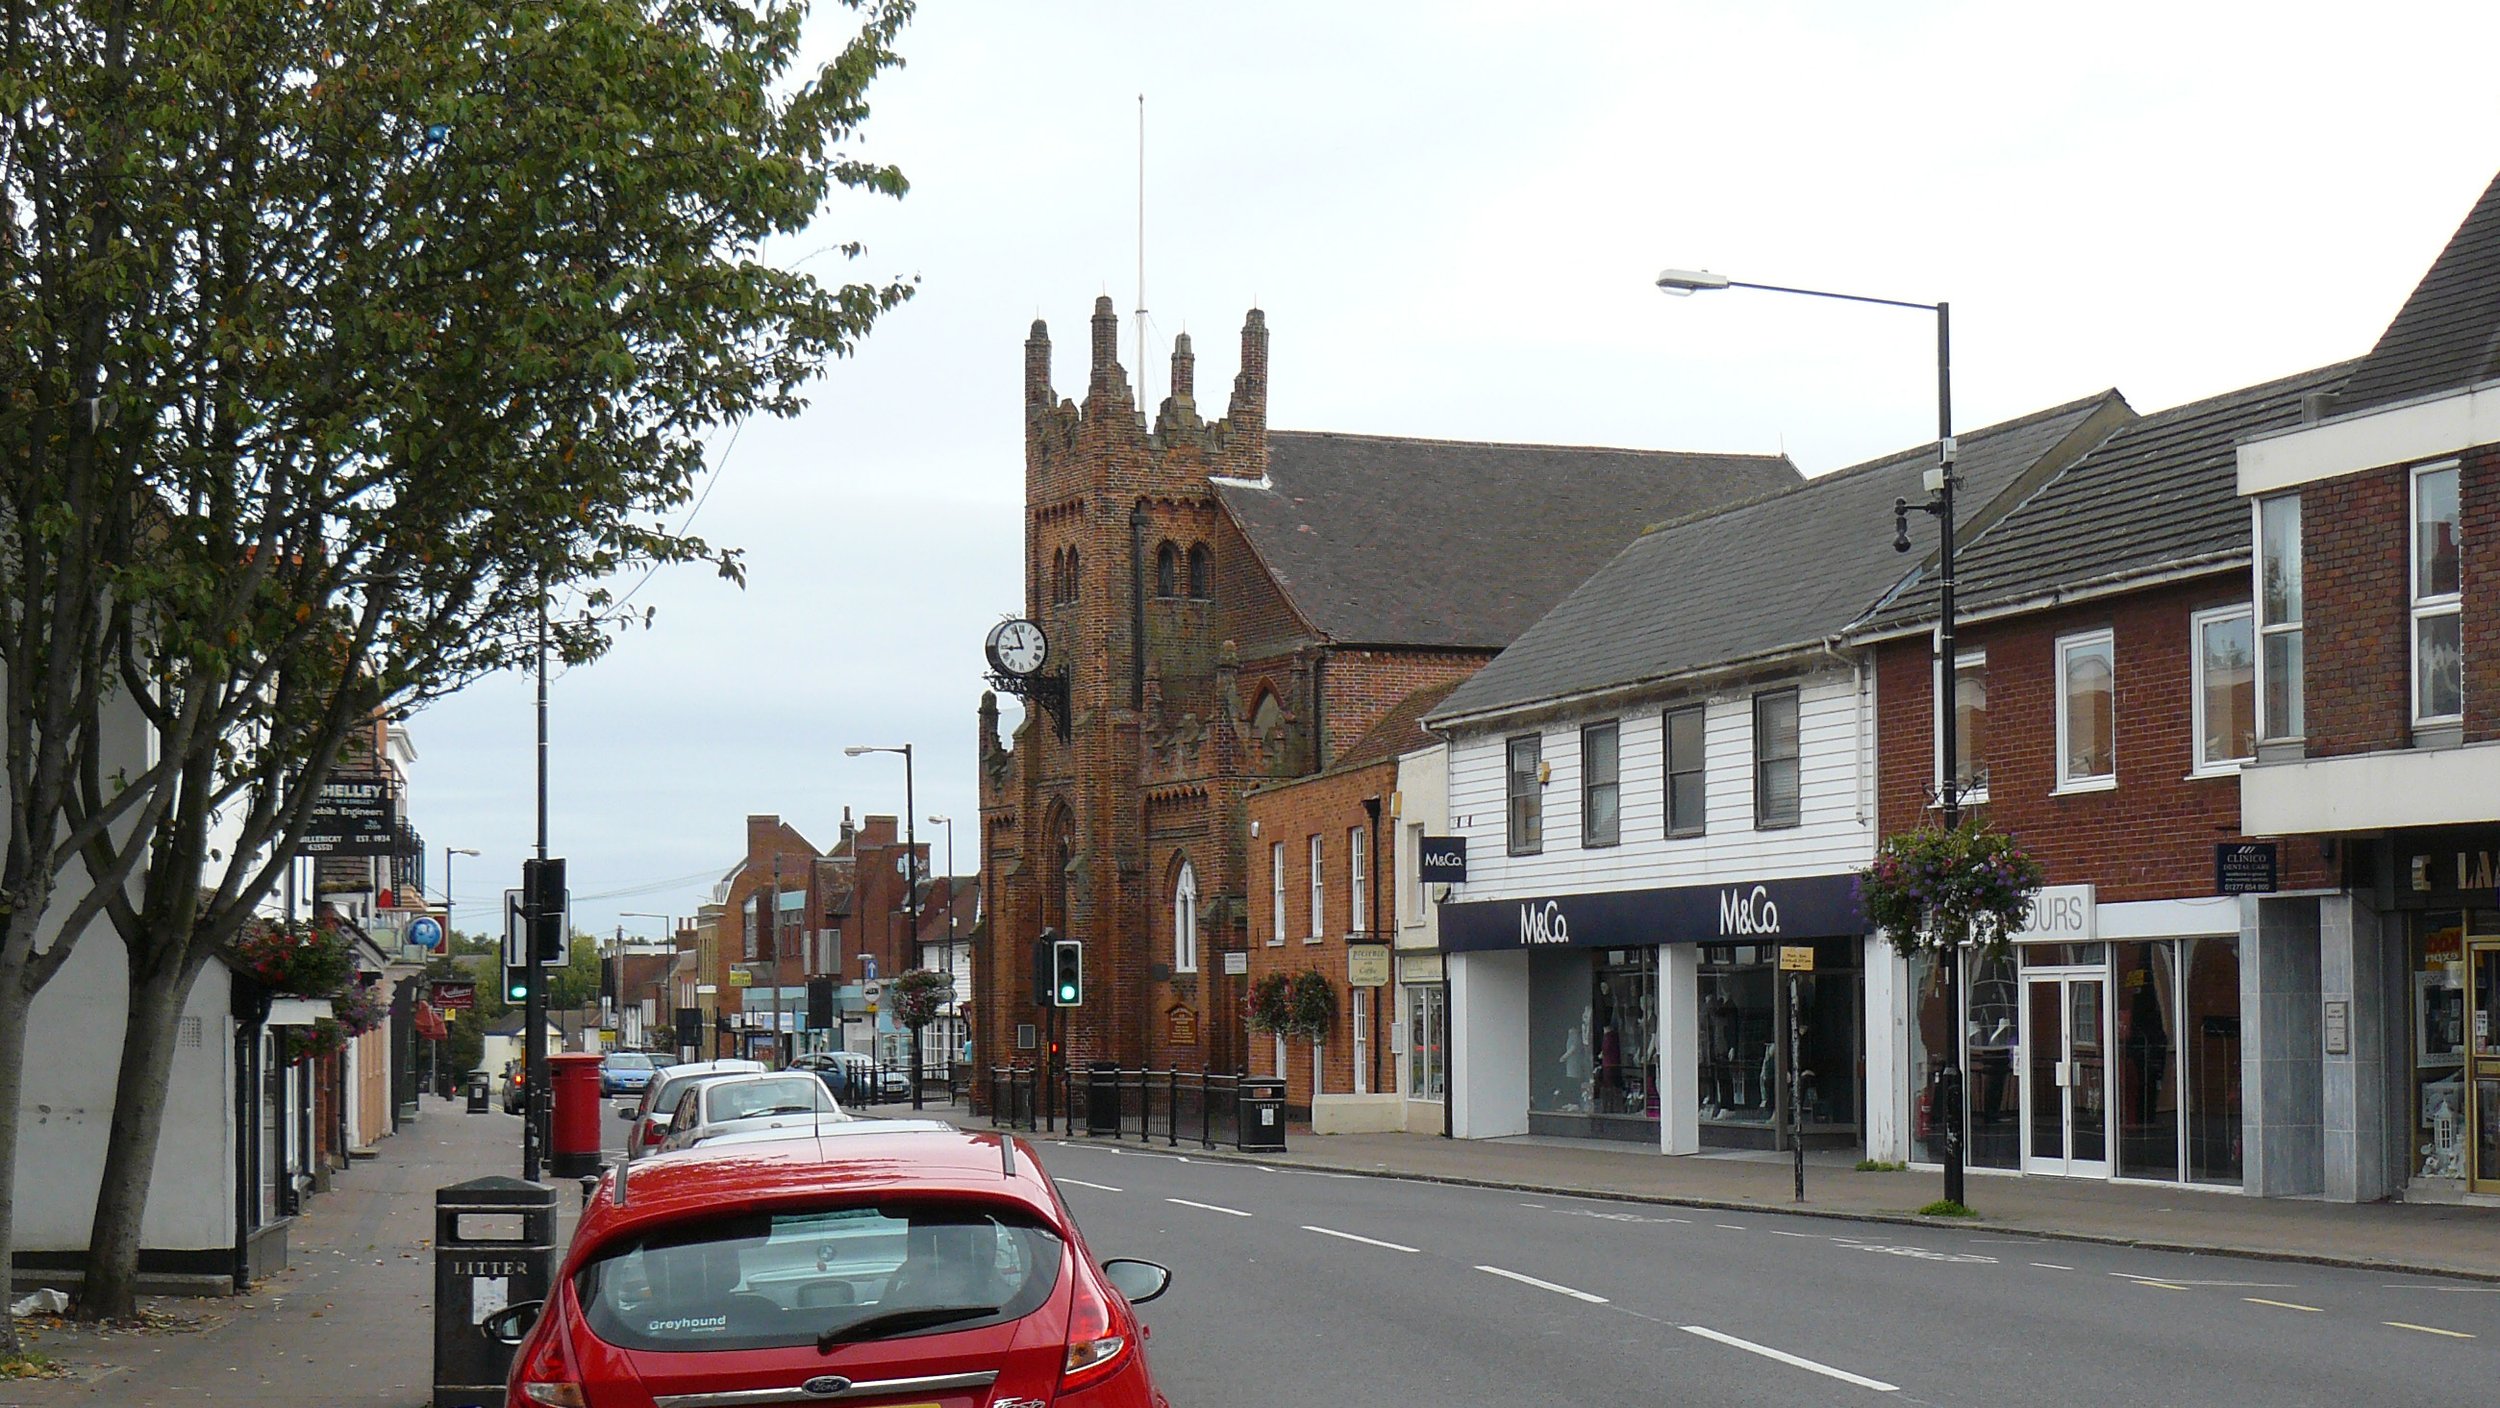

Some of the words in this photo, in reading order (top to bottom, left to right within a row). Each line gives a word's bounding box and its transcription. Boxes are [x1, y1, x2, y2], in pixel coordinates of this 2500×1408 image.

[341, 807, 384, 818] Engineers
[2227, 854, 2266, 863] CLINICO
[1719, 885, 1780, 935] M&Co.
[1521, 900, 1569, 944] M&Co.
[454, 1261, 527, 1275] LITTER
[649, 1315, 727, 1331] Greyhound
